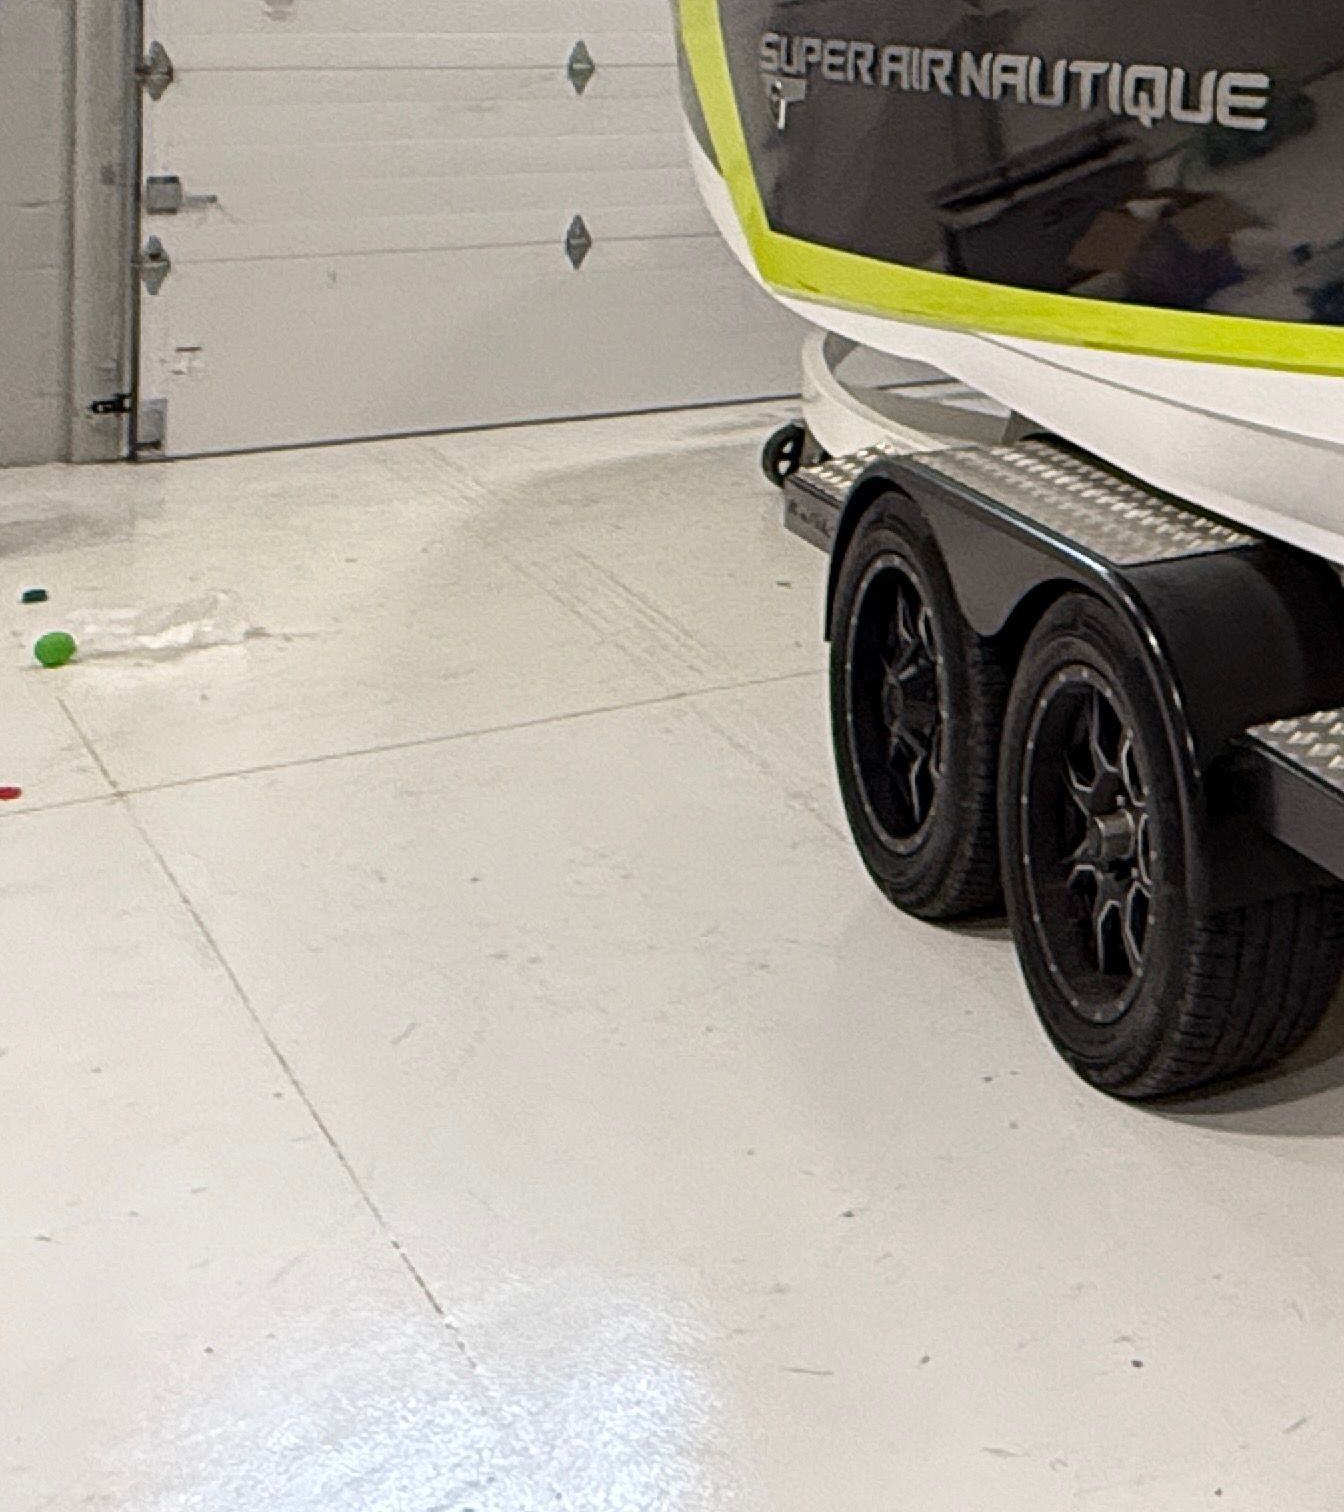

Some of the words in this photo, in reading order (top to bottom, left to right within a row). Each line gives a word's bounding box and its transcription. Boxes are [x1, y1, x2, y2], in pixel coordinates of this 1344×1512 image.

[758, 32, 874, 85] SUPER
[881, 45, 954, 95] AIR
[958, 51, 1271, 132] NAUTIQUE
